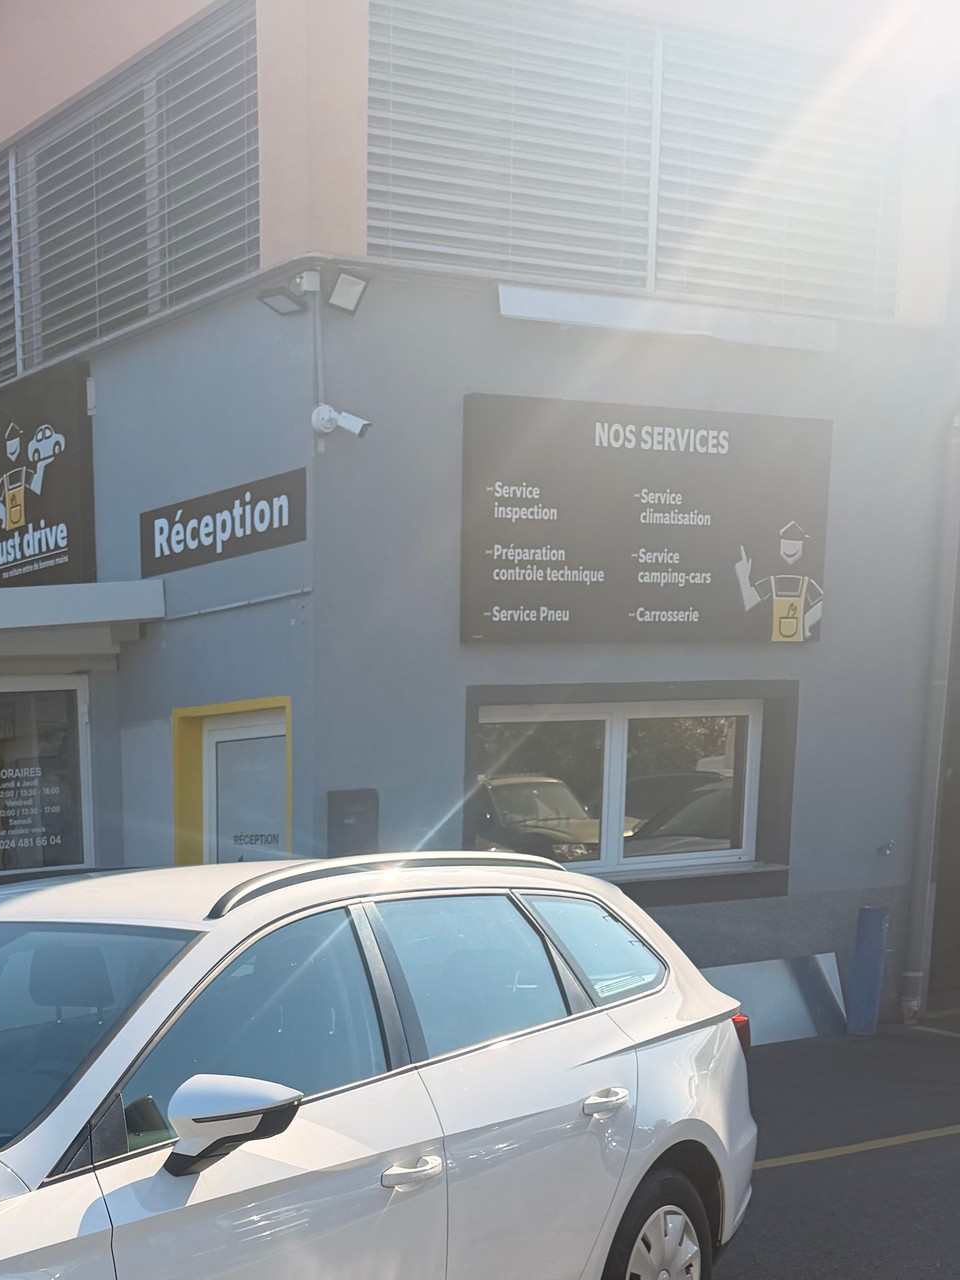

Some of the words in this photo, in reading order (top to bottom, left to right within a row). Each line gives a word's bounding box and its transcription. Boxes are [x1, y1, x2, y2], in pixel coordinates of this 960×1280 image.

[595, 422, 637, 449] NOS
[640, 425, 730, 455] SERVICES
[494, 481, 540, 499] Service
[640, 488, 683, 505] Service
[494, 502, 558, 523] inspection
[640, 508, 711, 526] climatisation
[154, 491, 289, 558] Réception
[23, 519, 68, 557] drive
[493, 543, 566, 564] Préparation
[638, 548, 680, 564] Service
[493, 564, 544, 581] contrôle
[546, 566, 605, 586] technique
[637, 568, 712, 588] camping-cars
[492, 606, 537, 622] Service
[539, 606, 570, 622] Pneu
[636, 606, 699, 622] Carrosserie
[18, 837, 33, 848] 481
[35, 836, 48, 847] 66
[49, 835, 61, 845] 04
[233, 832, 280, 846] RÉCEPTION
